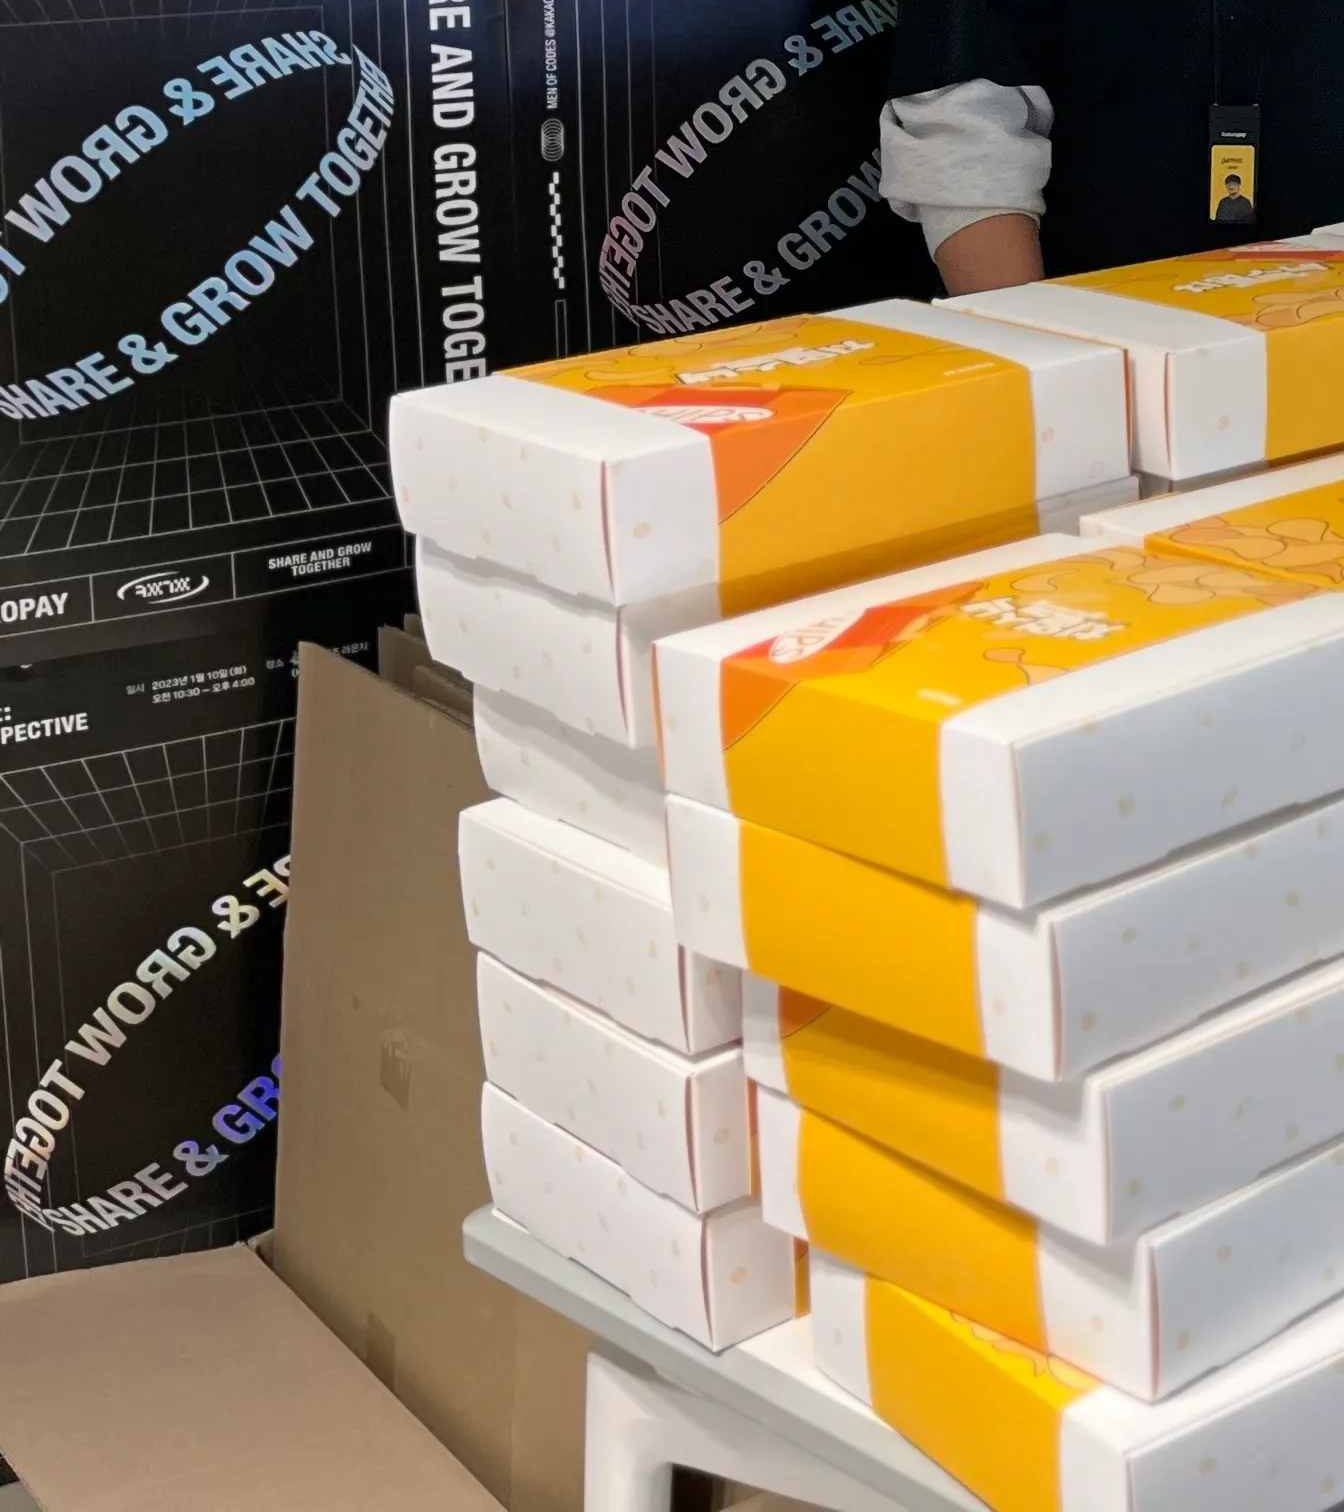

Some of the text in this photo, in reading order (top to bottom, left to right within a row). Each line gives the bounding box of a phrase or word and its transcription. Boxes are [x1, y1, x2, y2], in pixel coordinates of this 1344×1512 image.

[545, 39, 556, 71] CODES
[430, 41, 475, 130] AND
[546, 72, 557, 86] OF
[547, 87, 558, 109] MEN
[434, 141, 481, 266] GROW
[117, 333, 179, 373] &
[160, 205, 314, 343] GROW
[630, 275, 755, 334] SHARE
[268, 542, 372, 570] SHARE AND GROW
[290, 556, 351, 576] TOGETHER
[42, 1162, 190, 1236] SHARE
